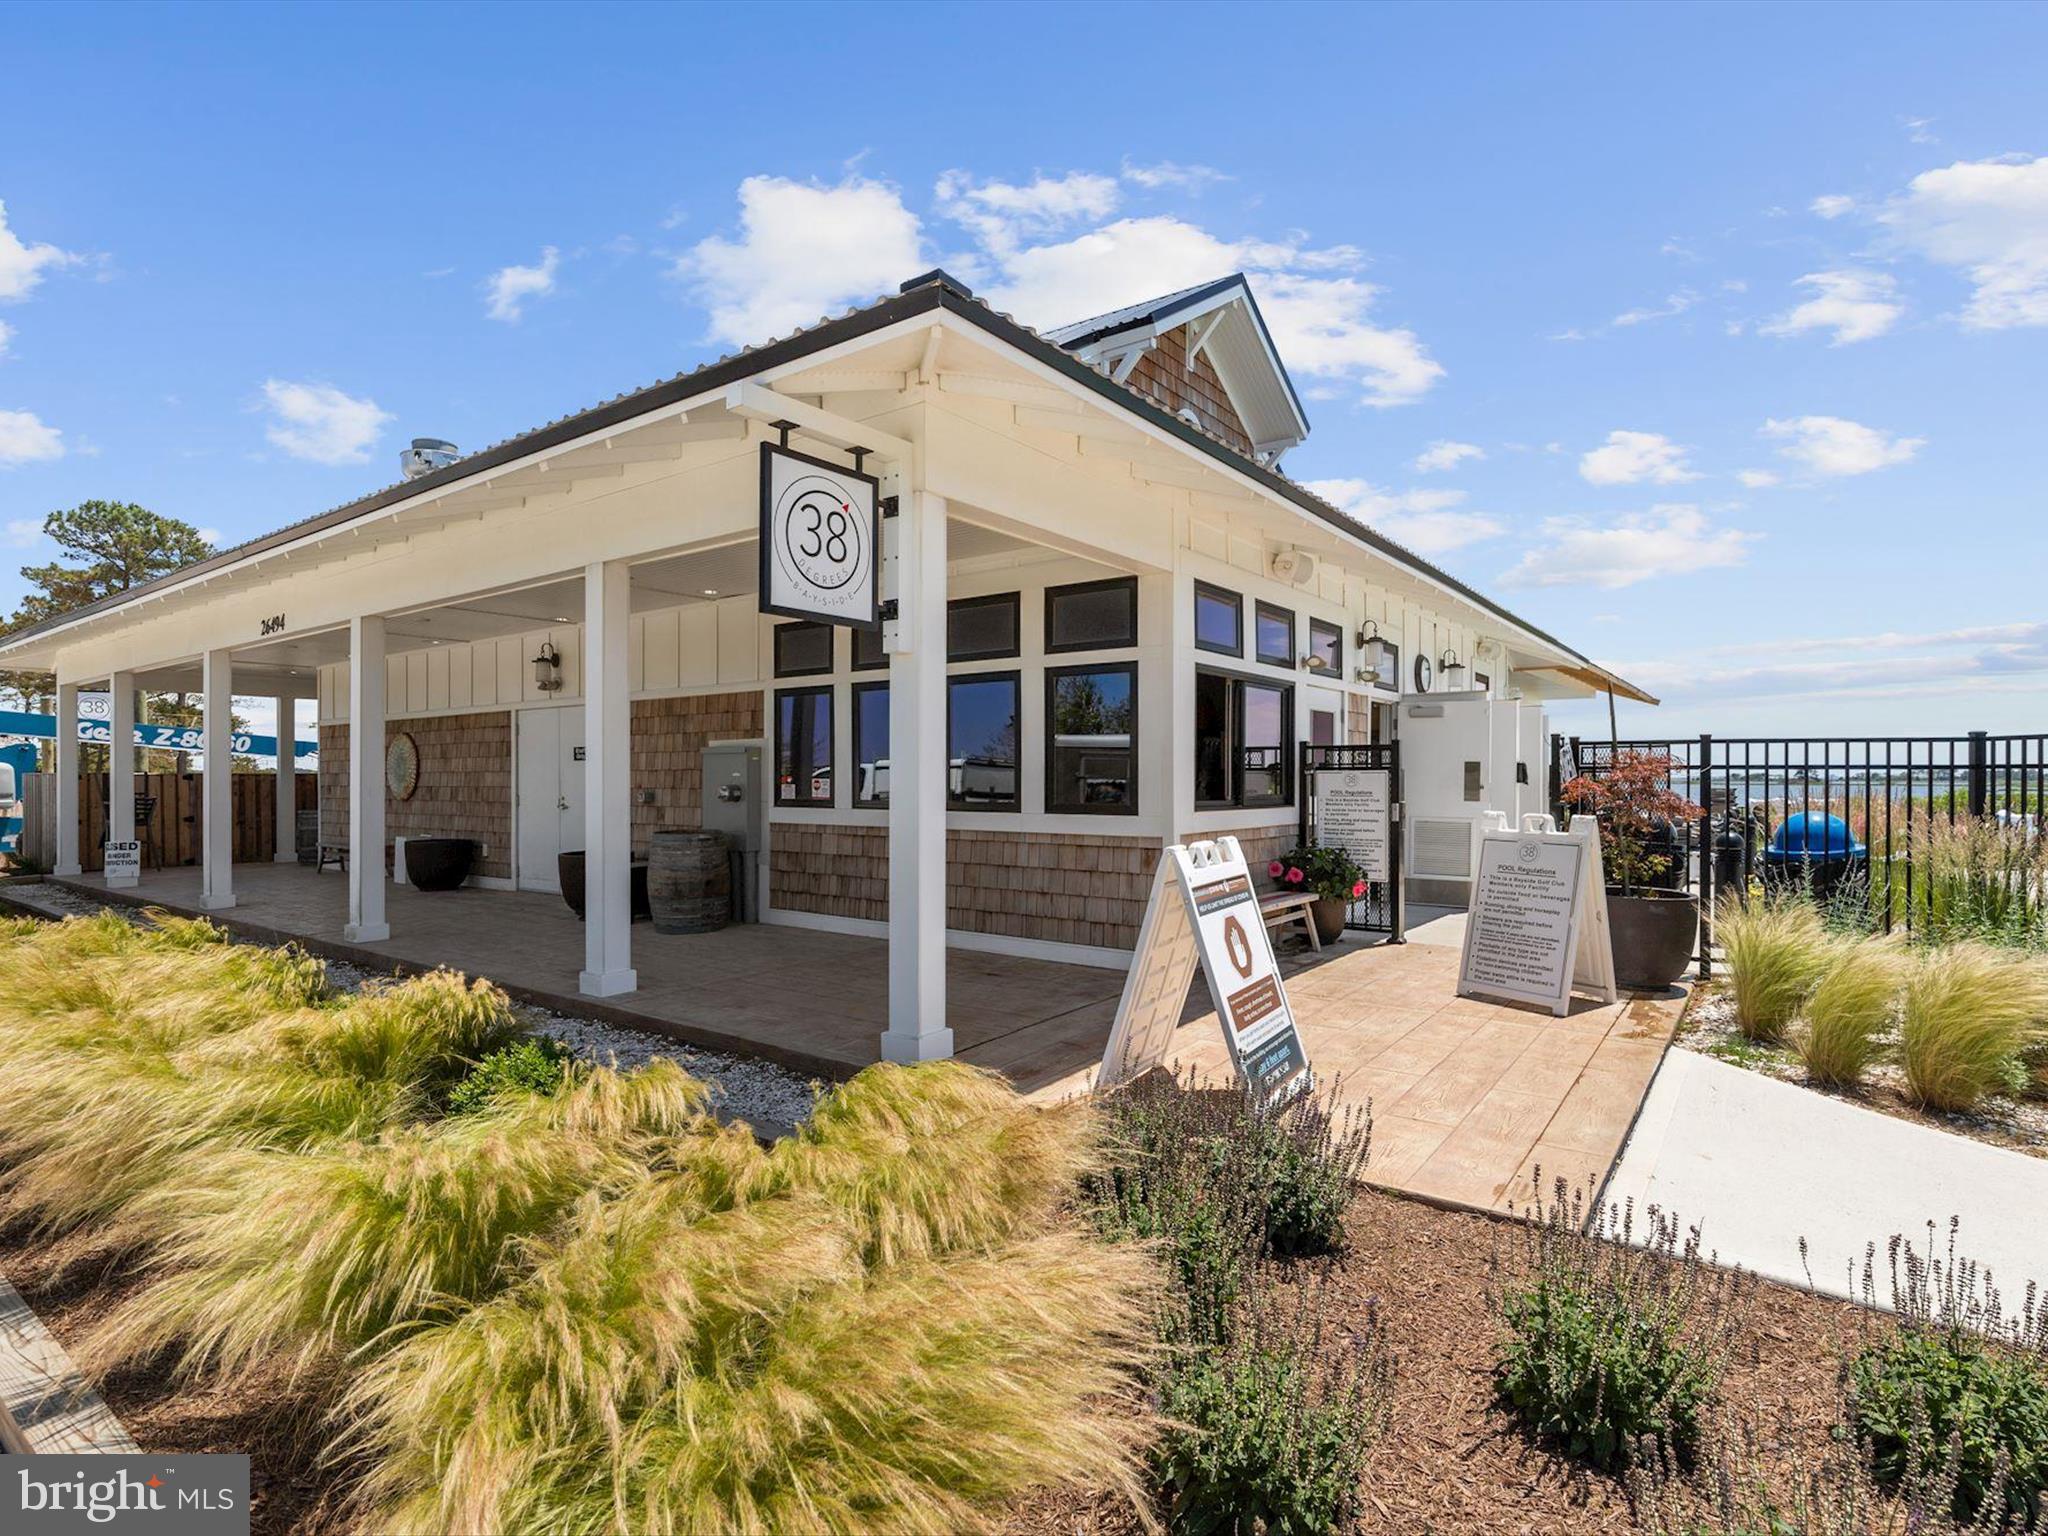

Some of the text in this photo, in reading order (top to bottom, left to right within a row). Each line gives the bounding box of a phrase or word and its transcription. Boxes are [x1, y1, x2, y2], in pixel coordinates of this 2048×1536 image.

[800, 503, 847, 564] 38
[799, 558, 850, 585] DEGREES
[260, 612, 286, 637] 26494
[83, 701, 105, 714] 38
[1522, 846, 1536, 858] 38
[1497, 864, 1556, 876] POOL Regulations
[1539, 893, 1571, 902] beverages
